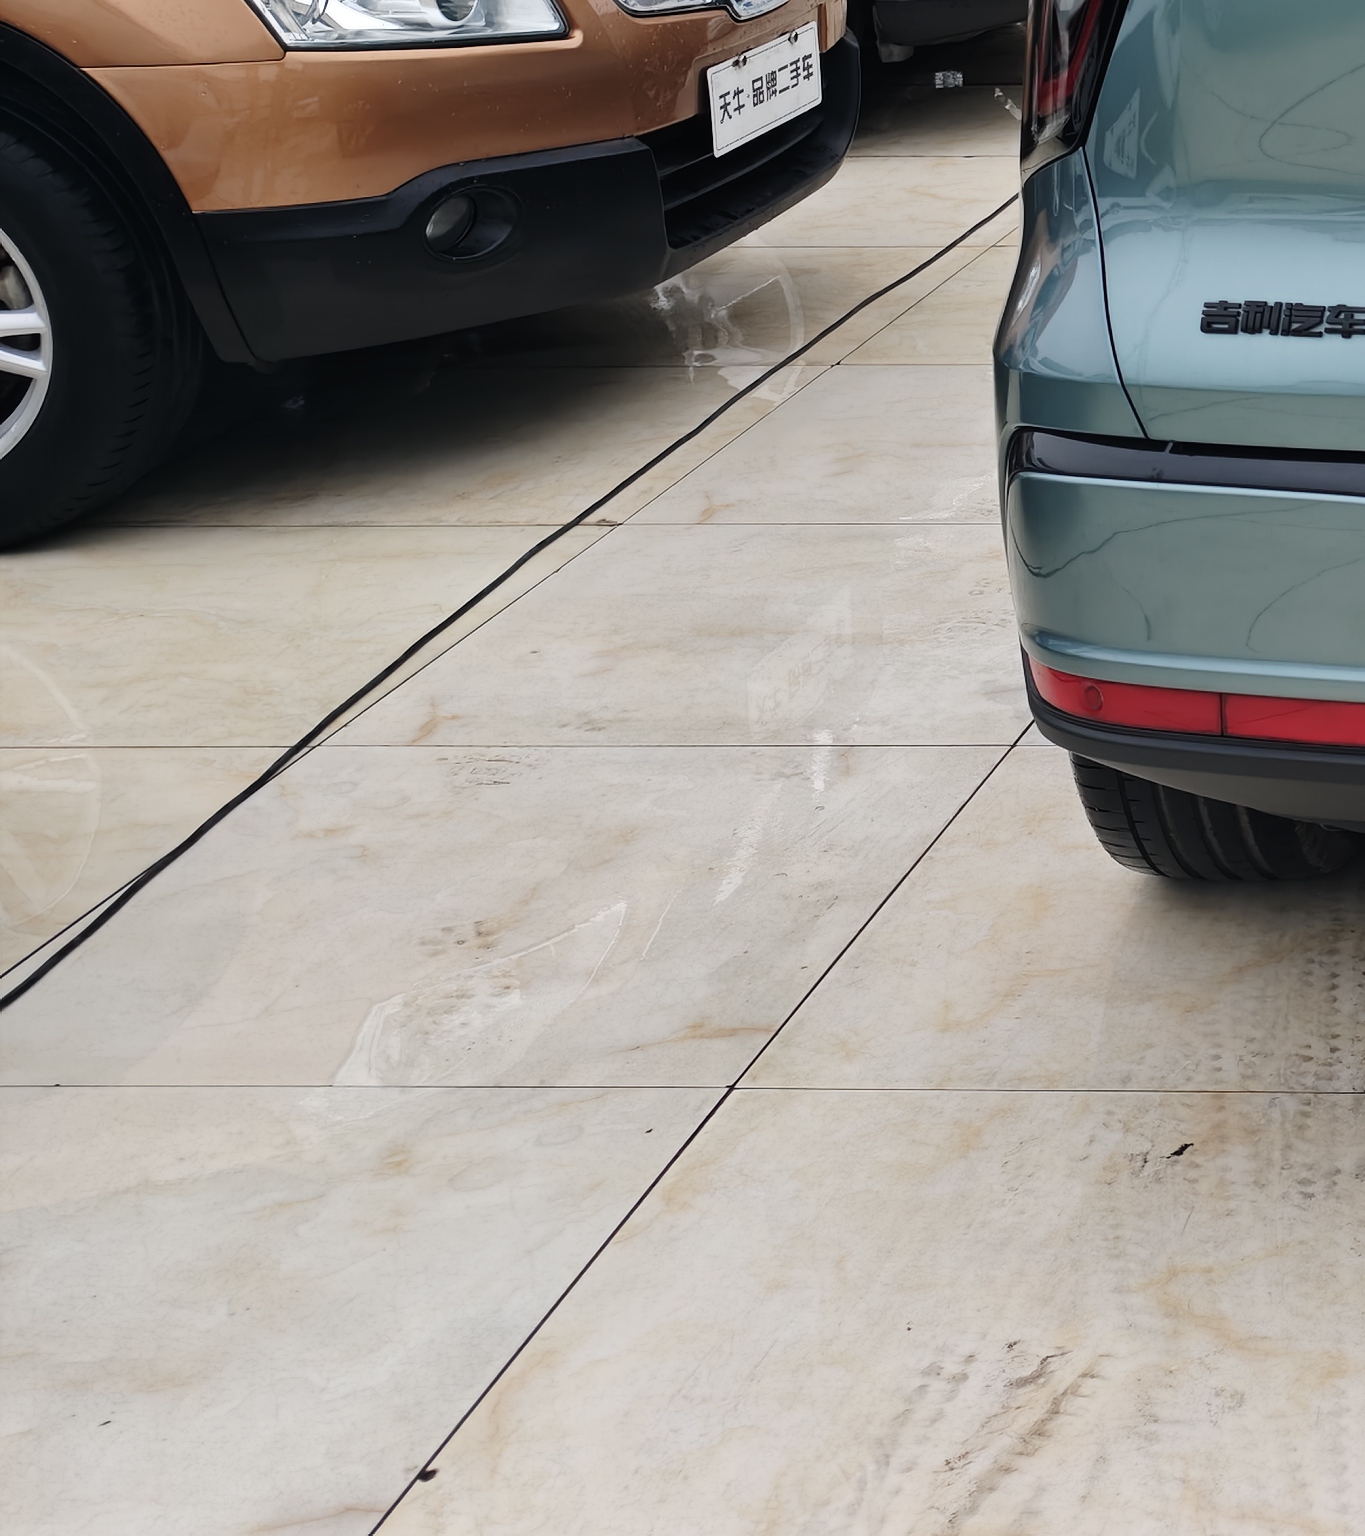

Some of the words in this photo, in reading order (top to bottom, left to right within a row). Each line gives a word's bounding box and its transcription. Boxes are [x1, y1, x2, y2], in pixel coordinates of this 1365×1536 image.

[718, 52, 814, 125] 天牛·品牌二手车
